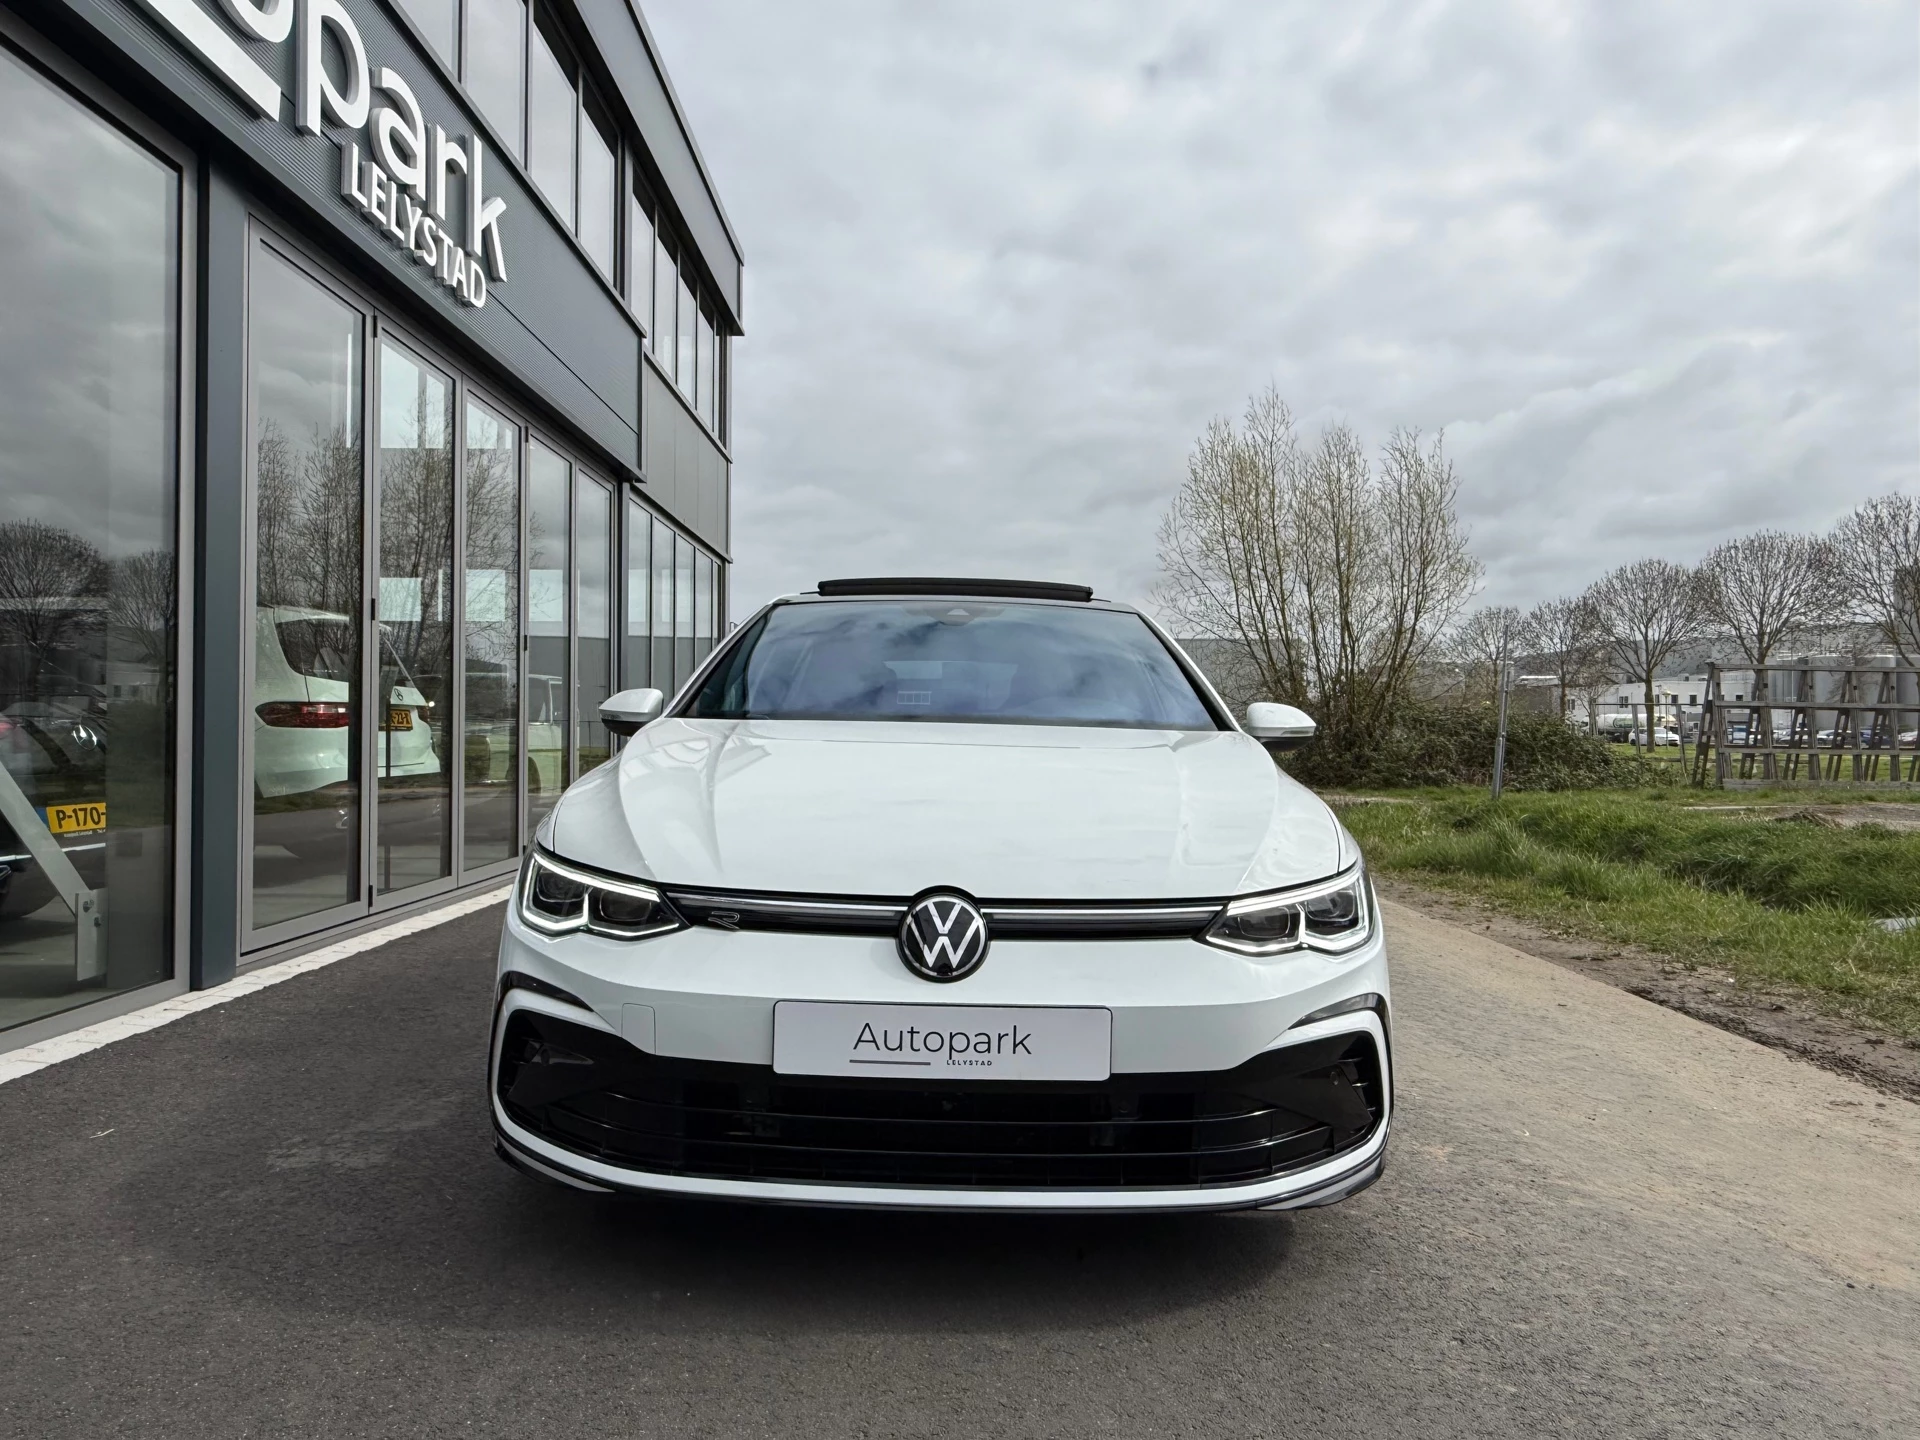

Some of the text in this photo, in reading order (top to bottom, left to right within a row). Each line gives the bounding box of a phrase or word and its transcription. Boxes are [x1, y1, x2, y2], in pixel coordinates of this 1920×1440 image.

[344, 141, 487, 309] LELYSTAD
[56, 806, 106, 829] P-170-
[853, 1022, 1032, 1061] Autopark
[946, 1059, 993, 1067] LELYSTAD
